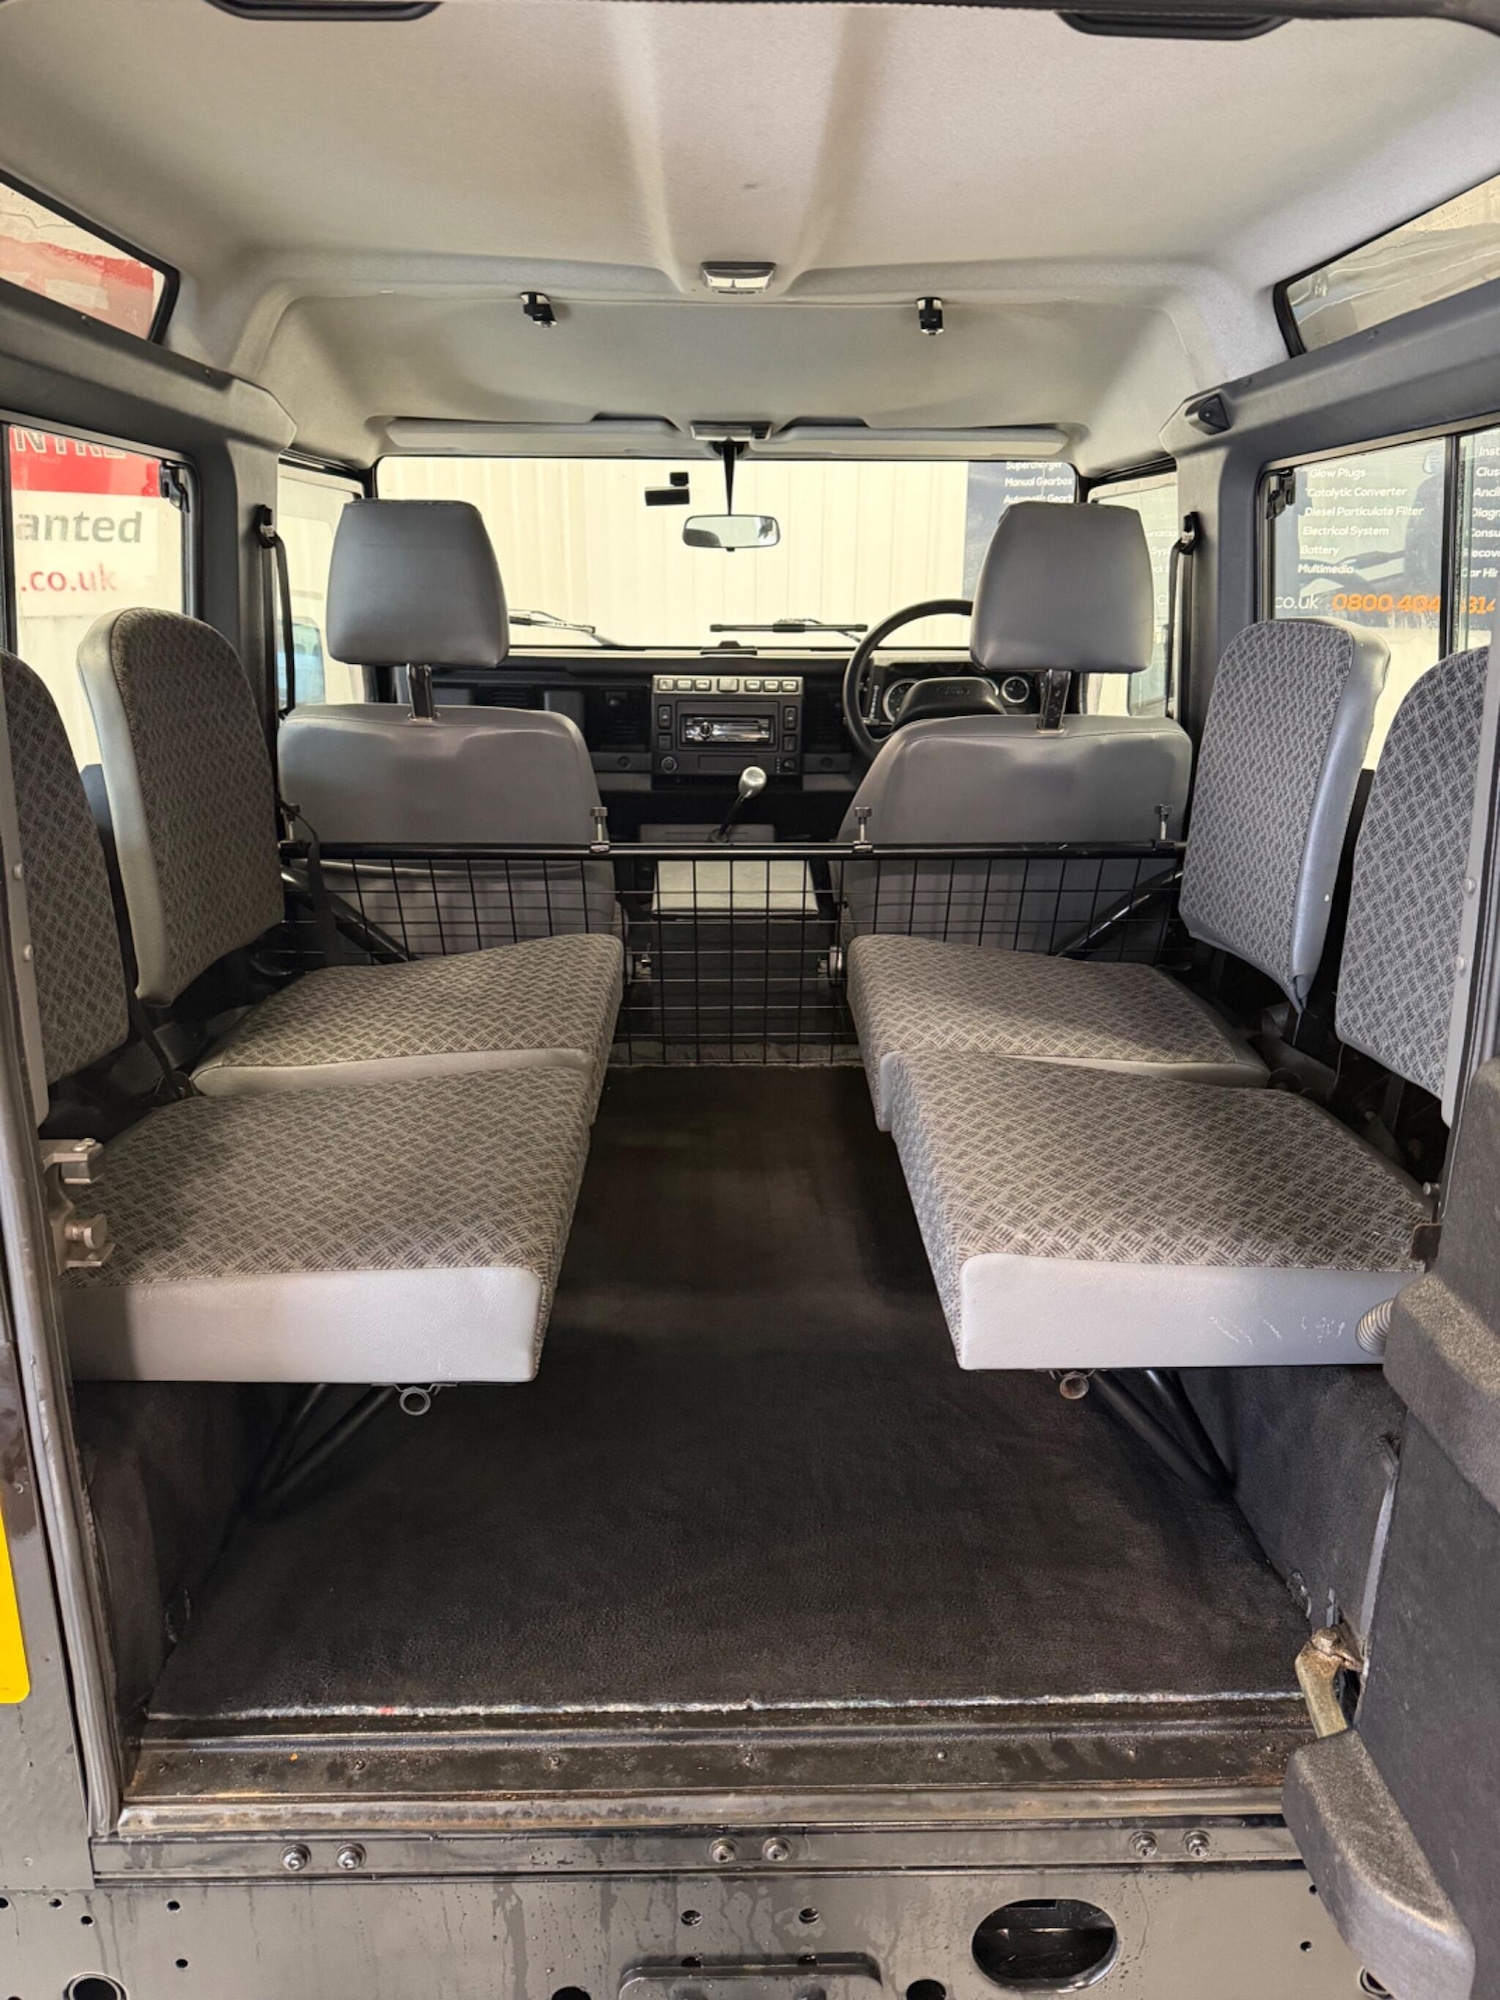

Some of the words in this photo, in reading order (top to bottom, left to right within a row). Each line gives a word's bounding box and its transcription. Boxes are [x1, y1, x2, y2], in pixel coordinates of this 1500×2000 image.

[1309, 468, 1336, 478] Glow
[1337, 468, 1366, 480] Plugs
[1005, 477, 1035, 487] Manual
[1036, 476, 1072, 487] Gearbox
[1306, 487, 1352, 500] Catalytic
[1354, 487, 1407, 498] Converter
[1304, 506, 1335, 517] Diesel
[1337, 506, 1394, 517] Particulate
[1395, 506, 1424, 517] Filter
[1303, 526, 1349, 537] Electrical
[1350, 526, 1389, 539] System
[1300, 545, 1340, 556] Battery
[1297, 563, 1355, 575] Multimedia
[20, 563, 118, 592] .co.uk
[1332, 593, 1392, 613] 0800
[1396, 594, 1441, 613] 404
